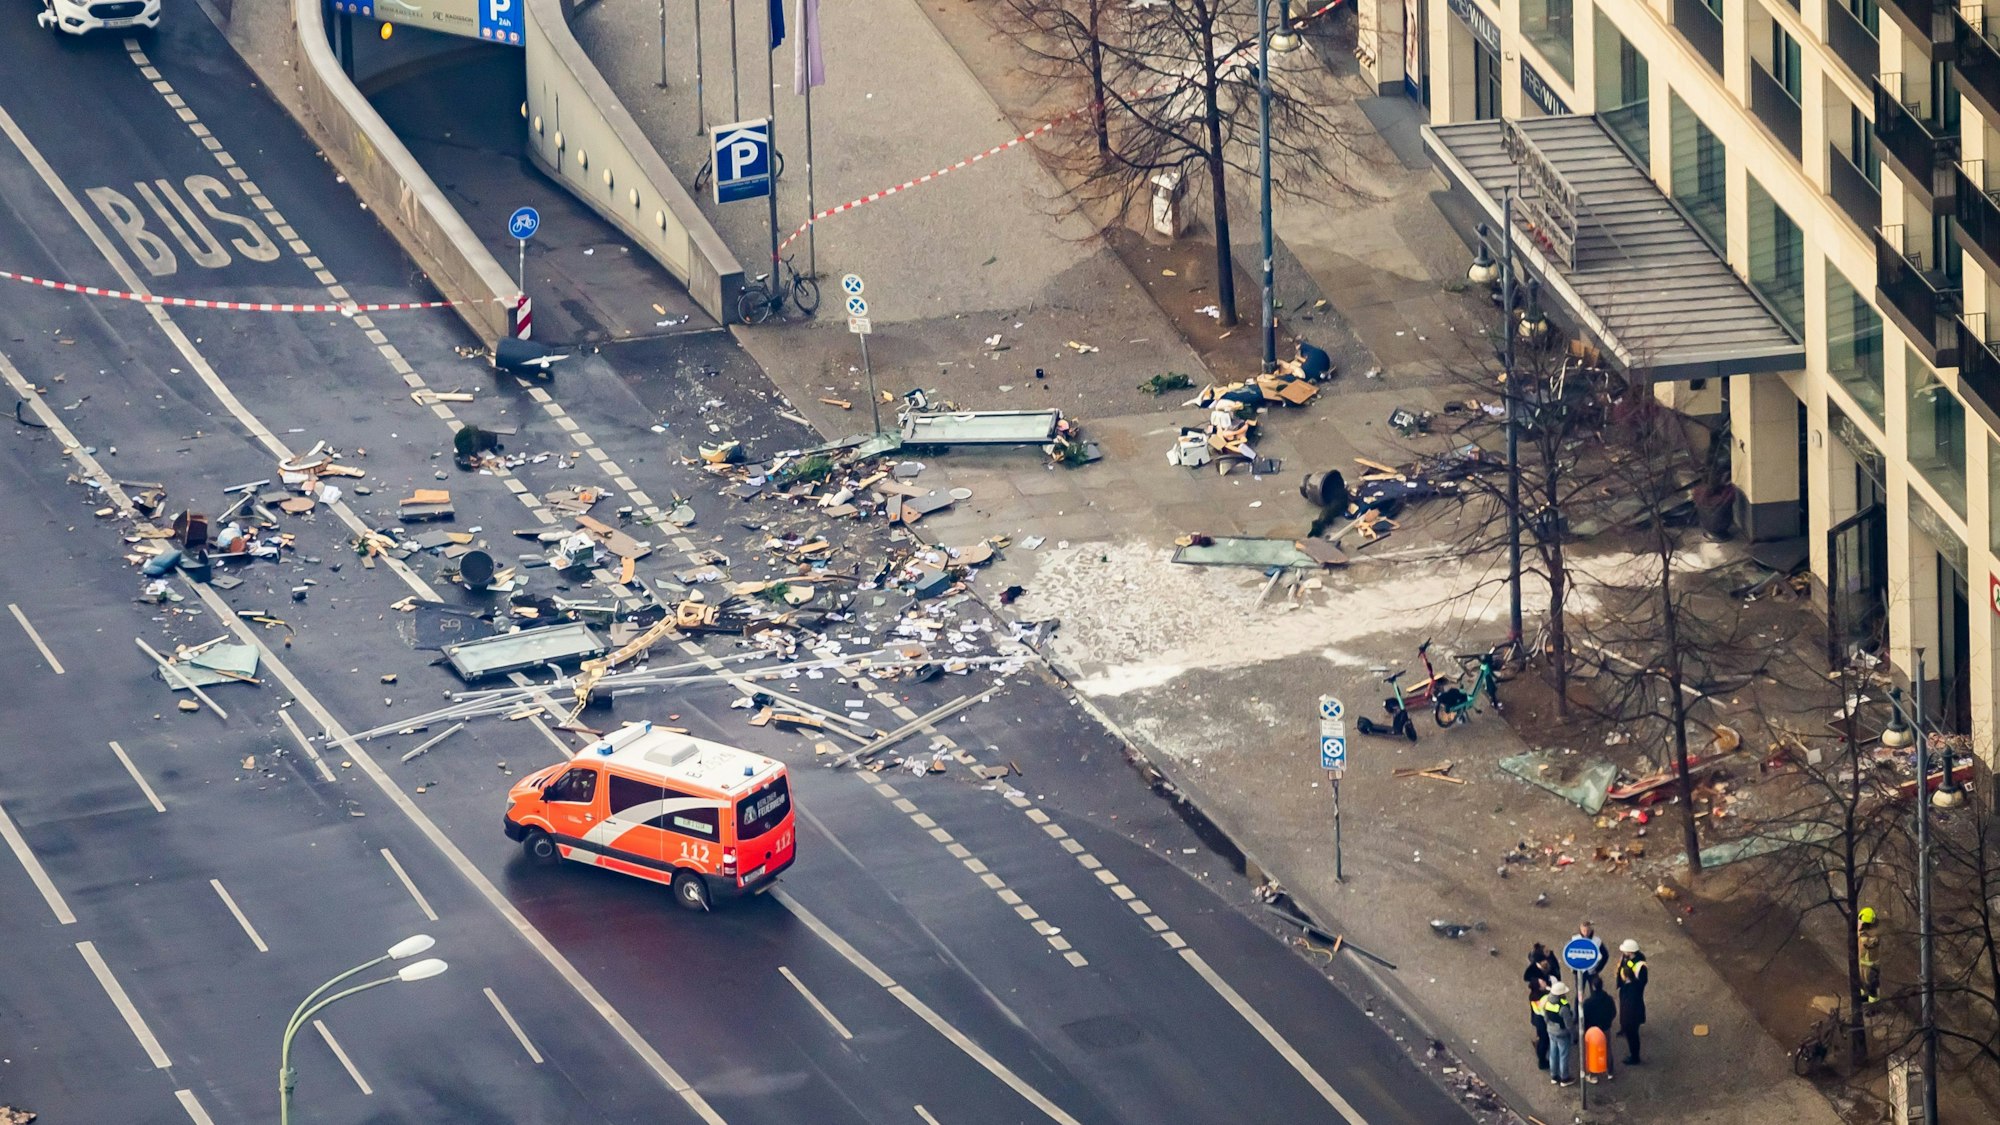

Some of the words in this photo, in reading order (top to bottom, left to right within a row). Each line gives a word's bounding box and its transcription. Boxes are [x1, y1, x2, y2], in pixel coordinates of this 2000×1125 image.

[498, 17, 511, 27] 24h
[731, 141, 758, 181] P
[85, 174, 280, 277] BUS
[680, 841, 710, 864] 112
[776, 830, 791, 854] 112
